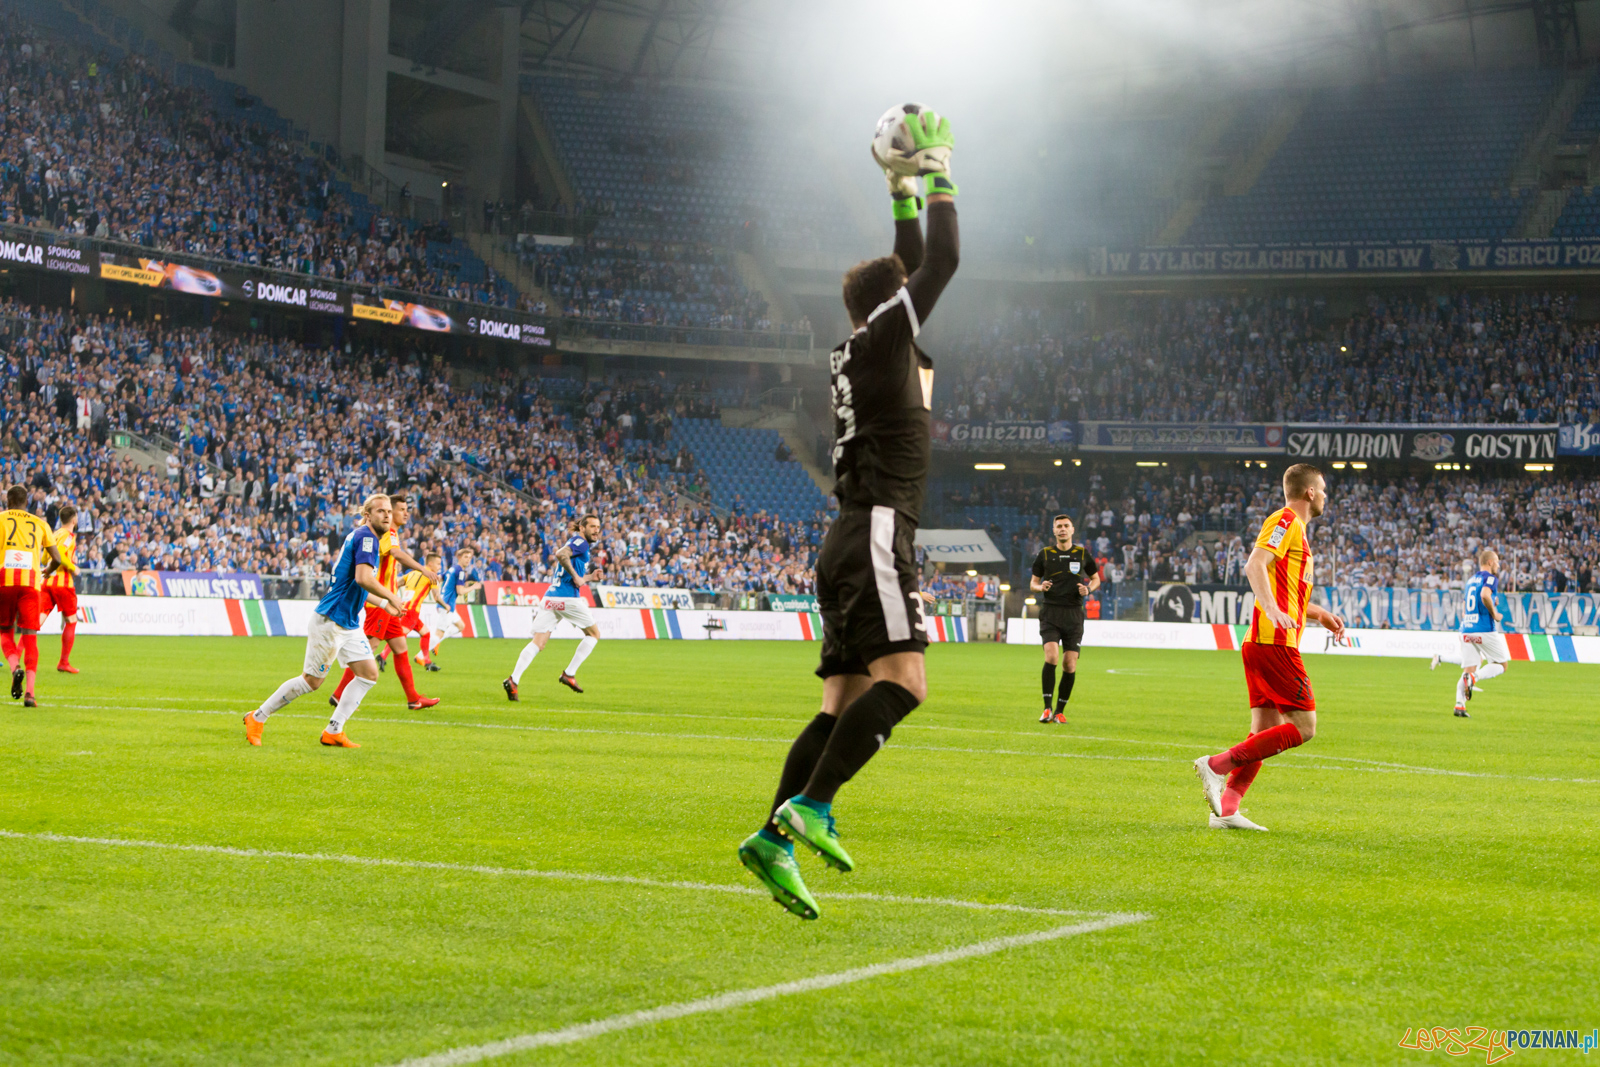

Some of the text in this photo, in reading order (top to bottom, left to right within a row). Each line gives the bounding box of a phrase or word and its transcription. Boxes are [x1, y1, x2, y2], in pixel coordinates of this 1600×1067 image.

[47, 245, 81, 260] SPONSOR
[1110, 252, 1131, 272] W
[1221, 249, 1348, 269] SZLACHETNA
[1357, 248, 1423, 268] KREW
[1466, 246, 1490, 266] W
[1495, 245, 1560, 265] SERCU
[257, 282, 307, 306] DOMCAR
[479, 318, 521, 341] DOMCAR
[950, 422, 1046, 441] Gniezno
[1287, 432, 1404, 459] SZWADRON
[6, 518, 36, 549] 23
[922, 543, 983, 553] FORTI
[165, 578, 262, 600] WWW.STS.PL
[1467, 586, 1477, 611] 6
[119, 609, 196, 628] outsourcing IT
[908, 591, 926, 631] 3
[376, 619, 384, 633] 5
